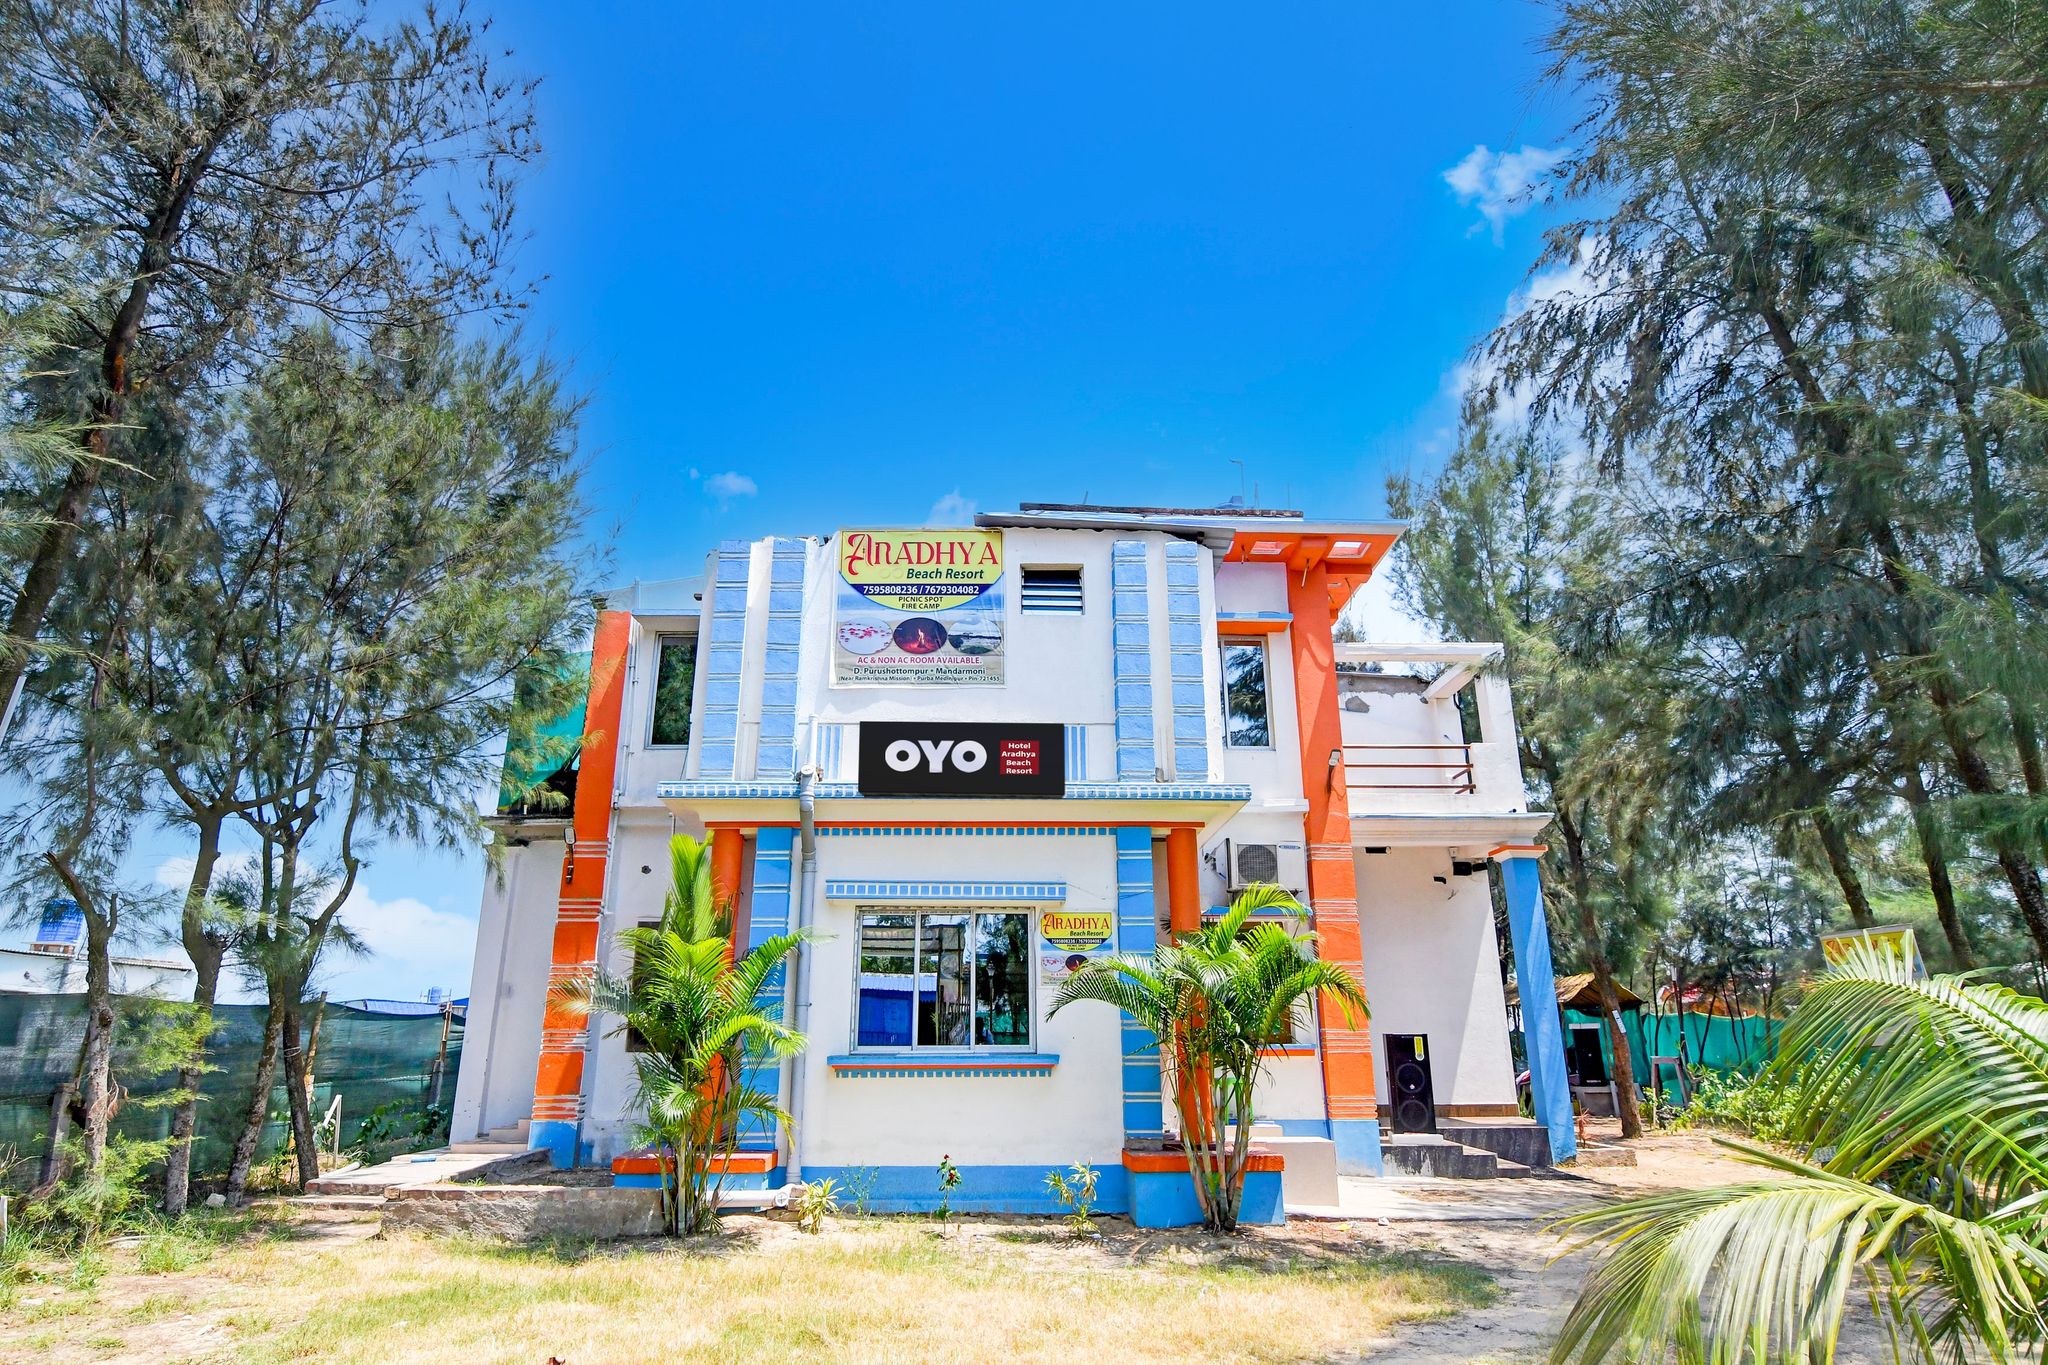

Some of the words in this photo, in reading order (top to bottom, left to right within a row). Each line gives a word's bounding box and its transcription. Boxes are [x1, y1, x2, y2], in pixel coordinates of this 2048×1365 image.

[845, 533, 998, 576] ARADHYA
[906, 568, 942, 579] Beach
[946, 568, 984, 579] Resort
[863, 586, 918, 594] 7595808236
[925, 586, 980, 594] 7679304082
[885, 739, 988, 773] OYO
[1002, 750, 1036, 758] Aradhya
[1042, 913, 1110, 934] ARADHYA
